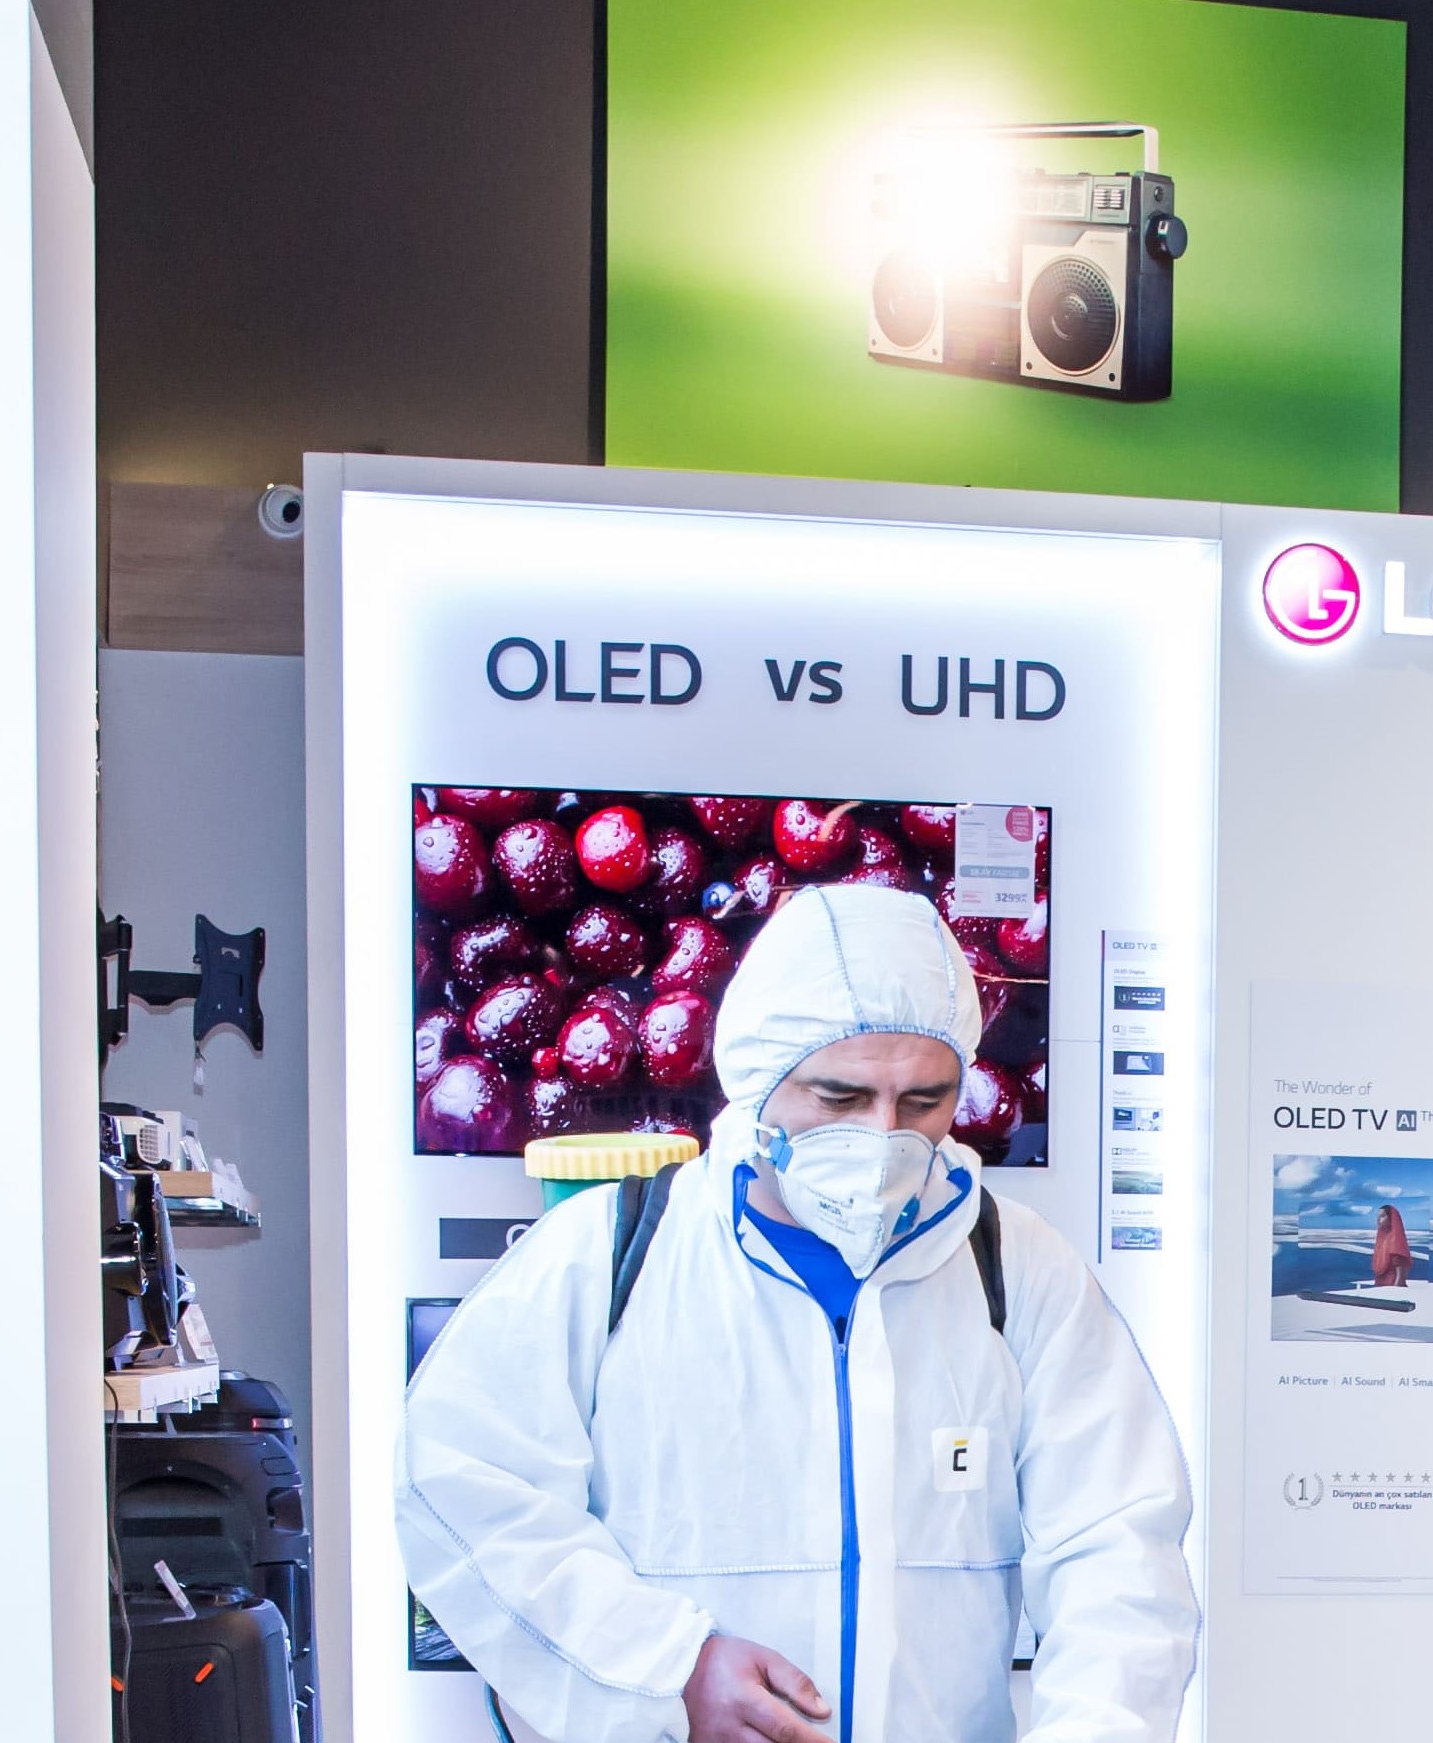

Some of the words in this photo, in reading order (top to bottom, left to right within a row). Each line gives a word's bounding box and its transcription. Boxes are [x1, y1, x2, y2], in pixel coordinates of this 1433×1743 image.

[486, 636, 703, 706] OLED
[765, 658, 844, 704] vs
[900, 654, 1067, 721] UHD
[1112, 941, 1135, 950] OLED
[1274, 1079, 1298, 1094] The
[1302, 1080, 1355, 1096] Wonder
[1358, 1082, 1373, 1097] of
[1273, 1105, 1346, 1130] OLED
[1352, 1107, 1389, 1131] TV
[1397, 1111, 1416, 1129] AI
[1278, 1376, 1289, 1386] AI
[1292, 1376, 1328, 1386] Picture
[1341, 1377, 1352, 1386] AI
[1355, 1376, 1386, 1386] Sound
[1398, 1377, 1409, 1387] AI
[1298, 1476, 1309, 1501] 1
[1353, 1501, 1377, 1510] OLED
